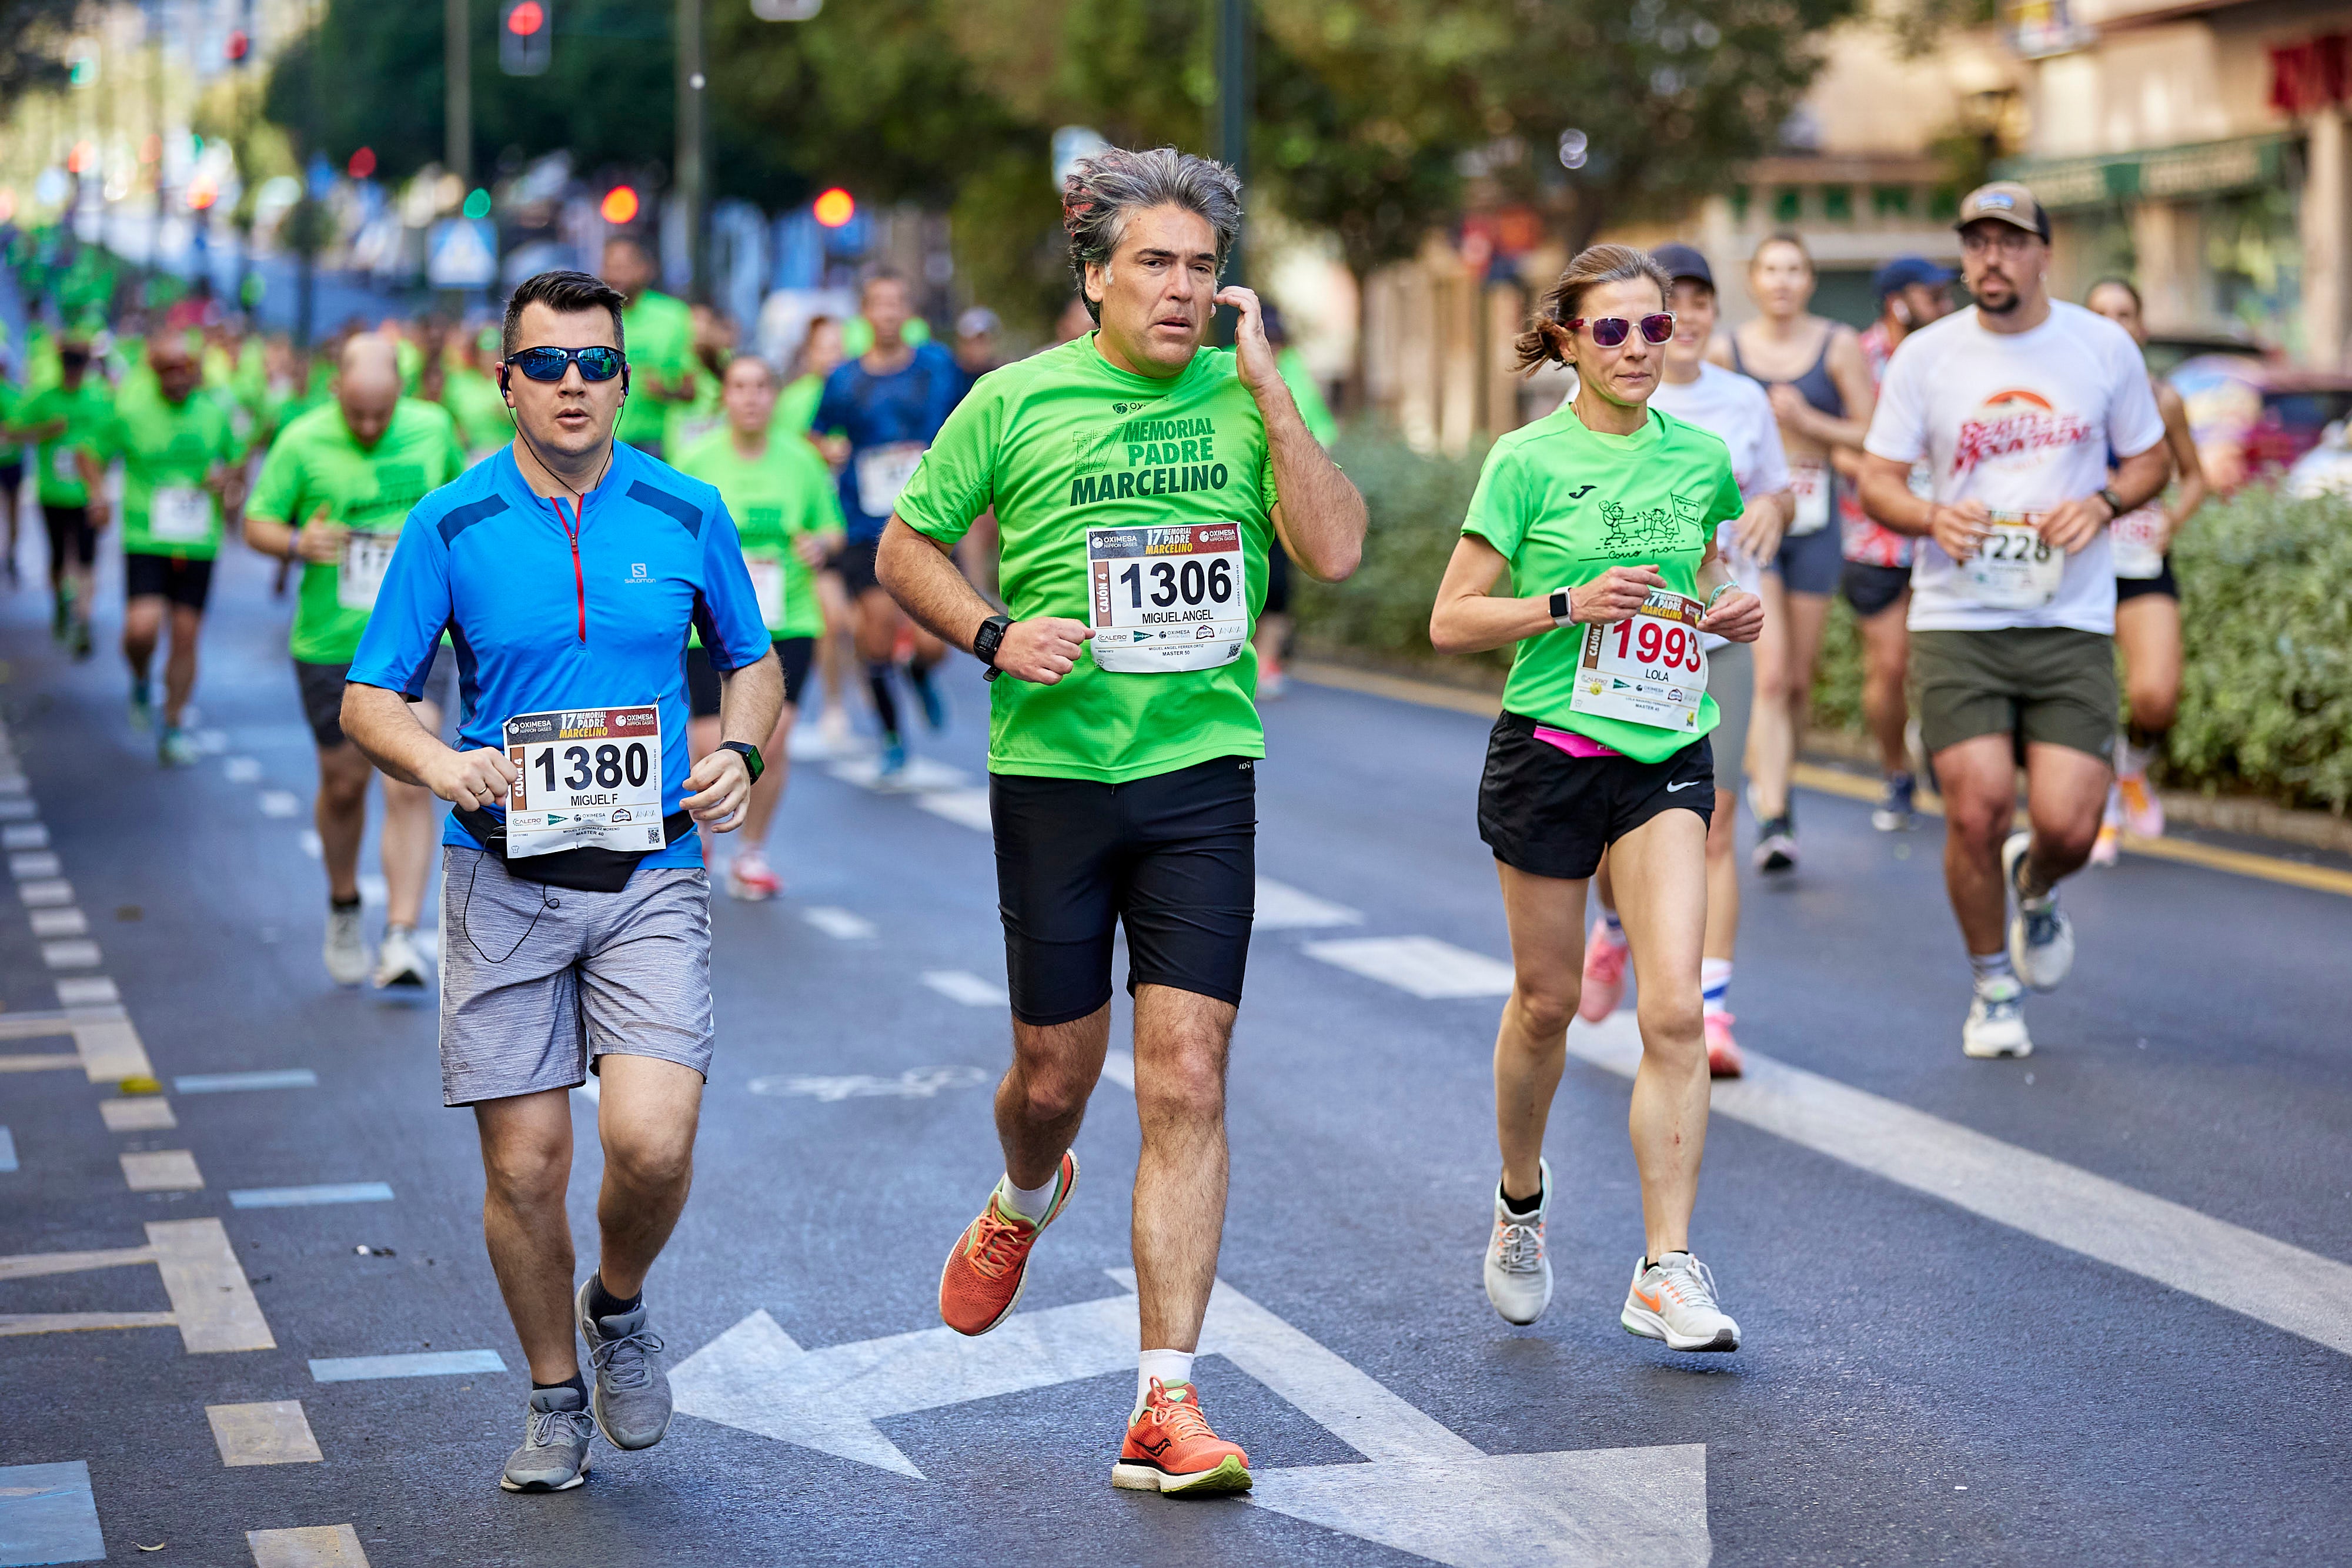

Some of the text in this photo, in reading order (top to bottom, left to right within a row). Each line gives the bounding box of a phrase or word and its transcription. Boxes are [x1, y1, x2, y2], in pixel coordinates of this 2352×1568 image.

[1073, 417, 1215, 476] 17 MEMORIAL
[1127, 437, 1214, 467] PADRE
[1070, 463, 1228, 506] MARCELINO
[1104, 535, 1138, 543] OXIMESA
[1147, 527, 1192, 546] 17 MEMORIAL
[1163, 534, 1190, 545] PADRE
[1145, 543, 1193, 555] MARCELINO
[1608, 550, 1642, 559] Corro
[1120, 558, 1232, 608] 1306
[1097, 583, 1109, 613] CAJÓN
[1658, 600, 1682, 611] PADRE
[1142, 609, 1214, 624] MIGUEL ANGEL
[1640, 604, 1682, 620] MARCELINO
[1589, 628, 1602, 657] CAJÓN
[1613, 618, 1701, 673] 1993
[1646, 668, 1669, 682] LOLA
[520, 720, 552, 728] OXIMESA
[560, 711, 607, 730] 17 MEMORIAL
[577, 718, 605, 729] PADRE
[559, 726, 608, 739] MARCELINO
[536, 743, 649, 791] 1380
[570, 794, 618, 806] MIGUEL F
